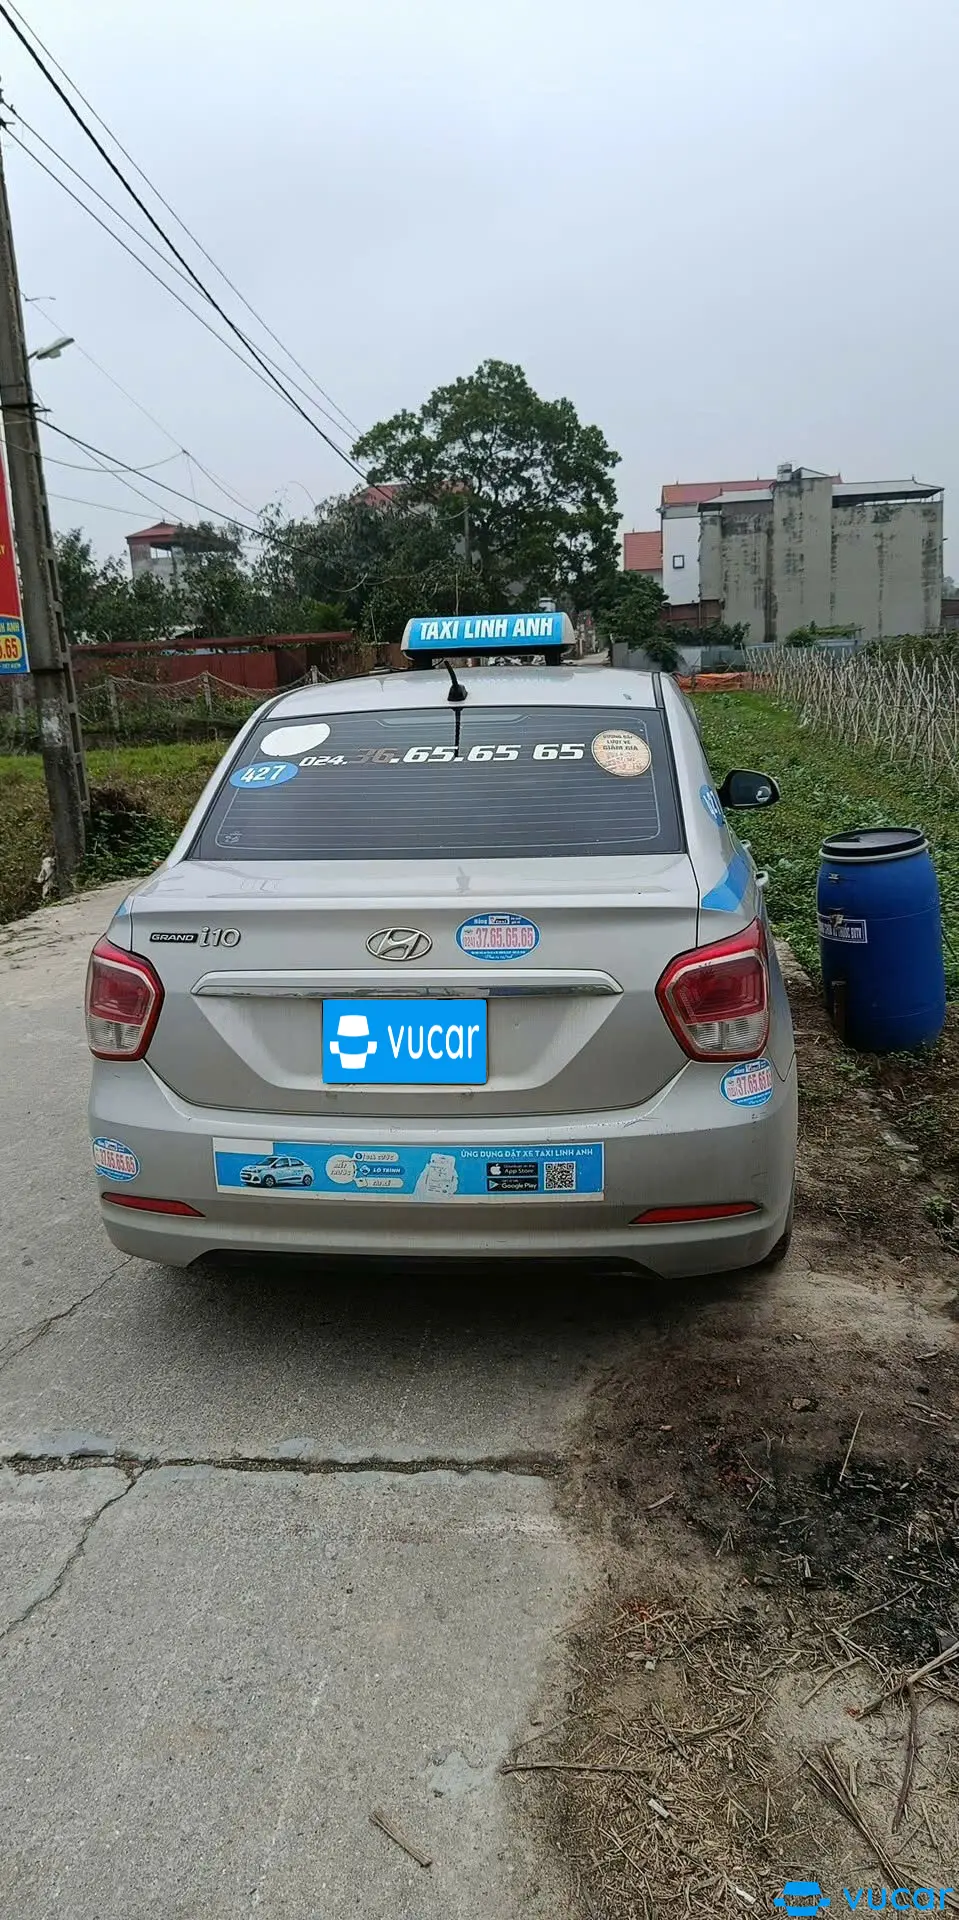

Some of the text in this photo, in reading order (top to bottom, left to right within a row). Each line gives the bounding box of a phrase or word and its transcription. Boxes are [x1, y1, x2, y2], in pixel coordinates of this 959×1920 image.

[420, 617, 554, 641] TAXI LINH ANH
[532, 743, 585, 760] 65
[240, 764, 287, 783] 427
[151, 926, 241, 947] GRAND i10
[461, 1148, 479, 1158] ỨNG
[481, 1150, 503, 1159] DỤNG
[575, 1148, 593, 1156] ANH
